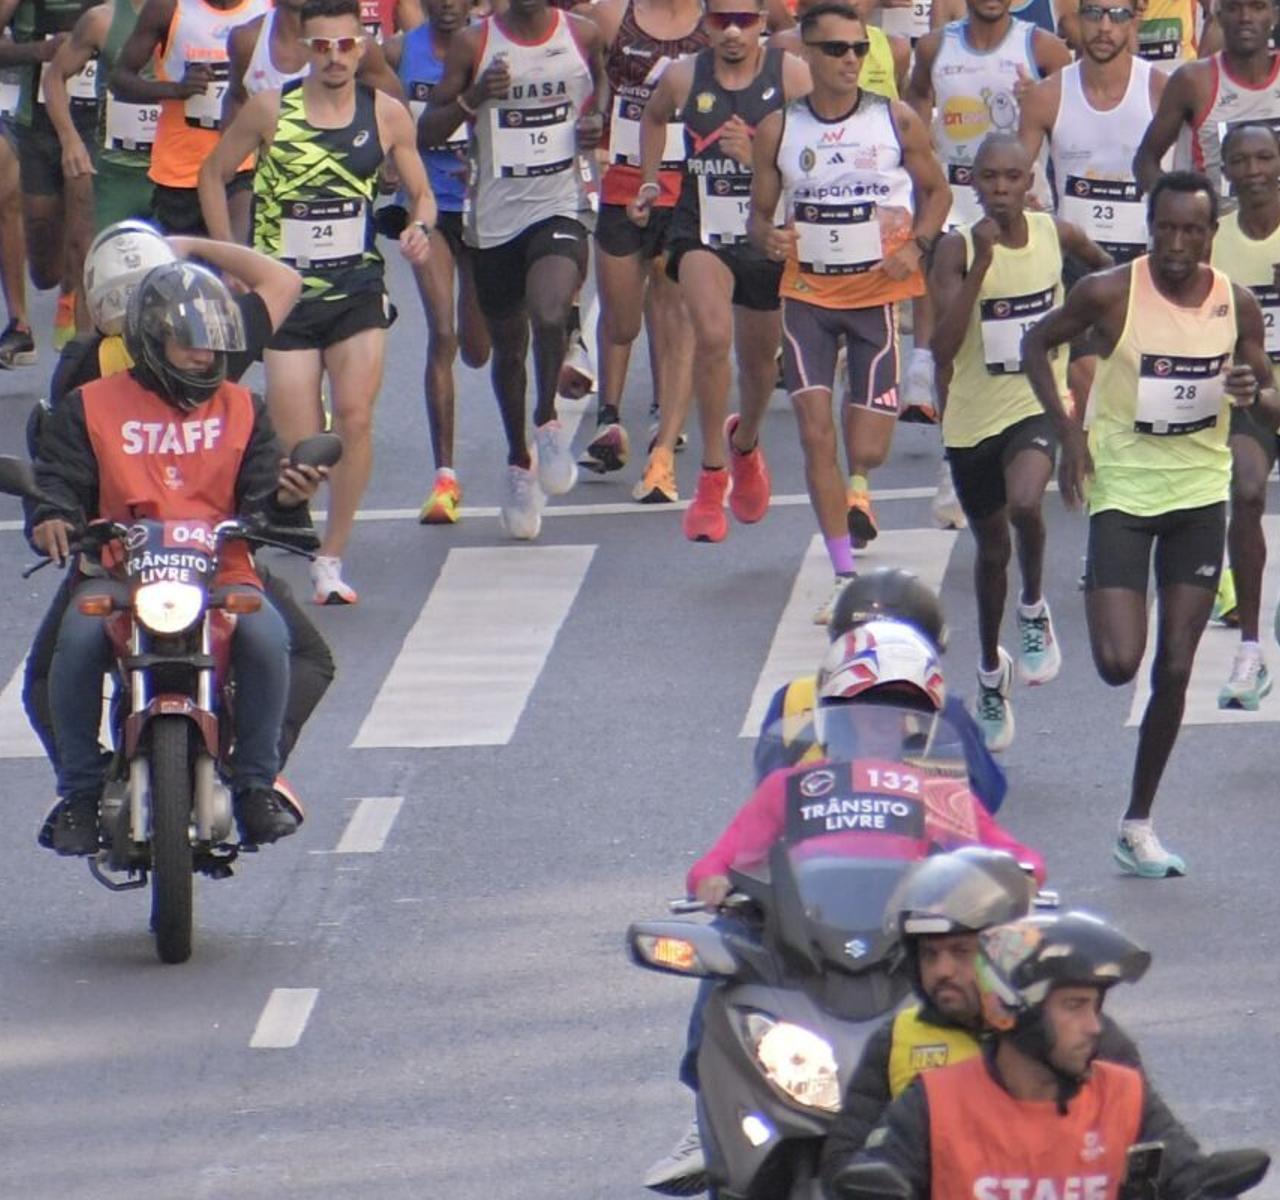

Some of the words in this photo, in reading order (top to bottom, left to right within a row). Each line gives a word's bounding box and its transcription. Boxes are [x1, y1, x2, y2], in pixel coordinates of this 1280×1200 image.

[137, 109, 159, 123] 38
[530, 130, 548, 144] 16
[687, 158, 736, 175] PRAIA
[1093, 205, 1115, 220] 23
[312, 225, 333, 238] 24
[829, 230, 840, 244] 5
[1174, 384, 1198, 400] 28
[121, 417, 221, 456] STAFF
[125, 550, 208, 576] TRÂNSITO
[141, 568, 190, 584] LIVRE
[867, 768, 919, 794] 132
[799, 797, 909, 821] TRÂNSITO
[825, 813, 886, 831] LIVRE
